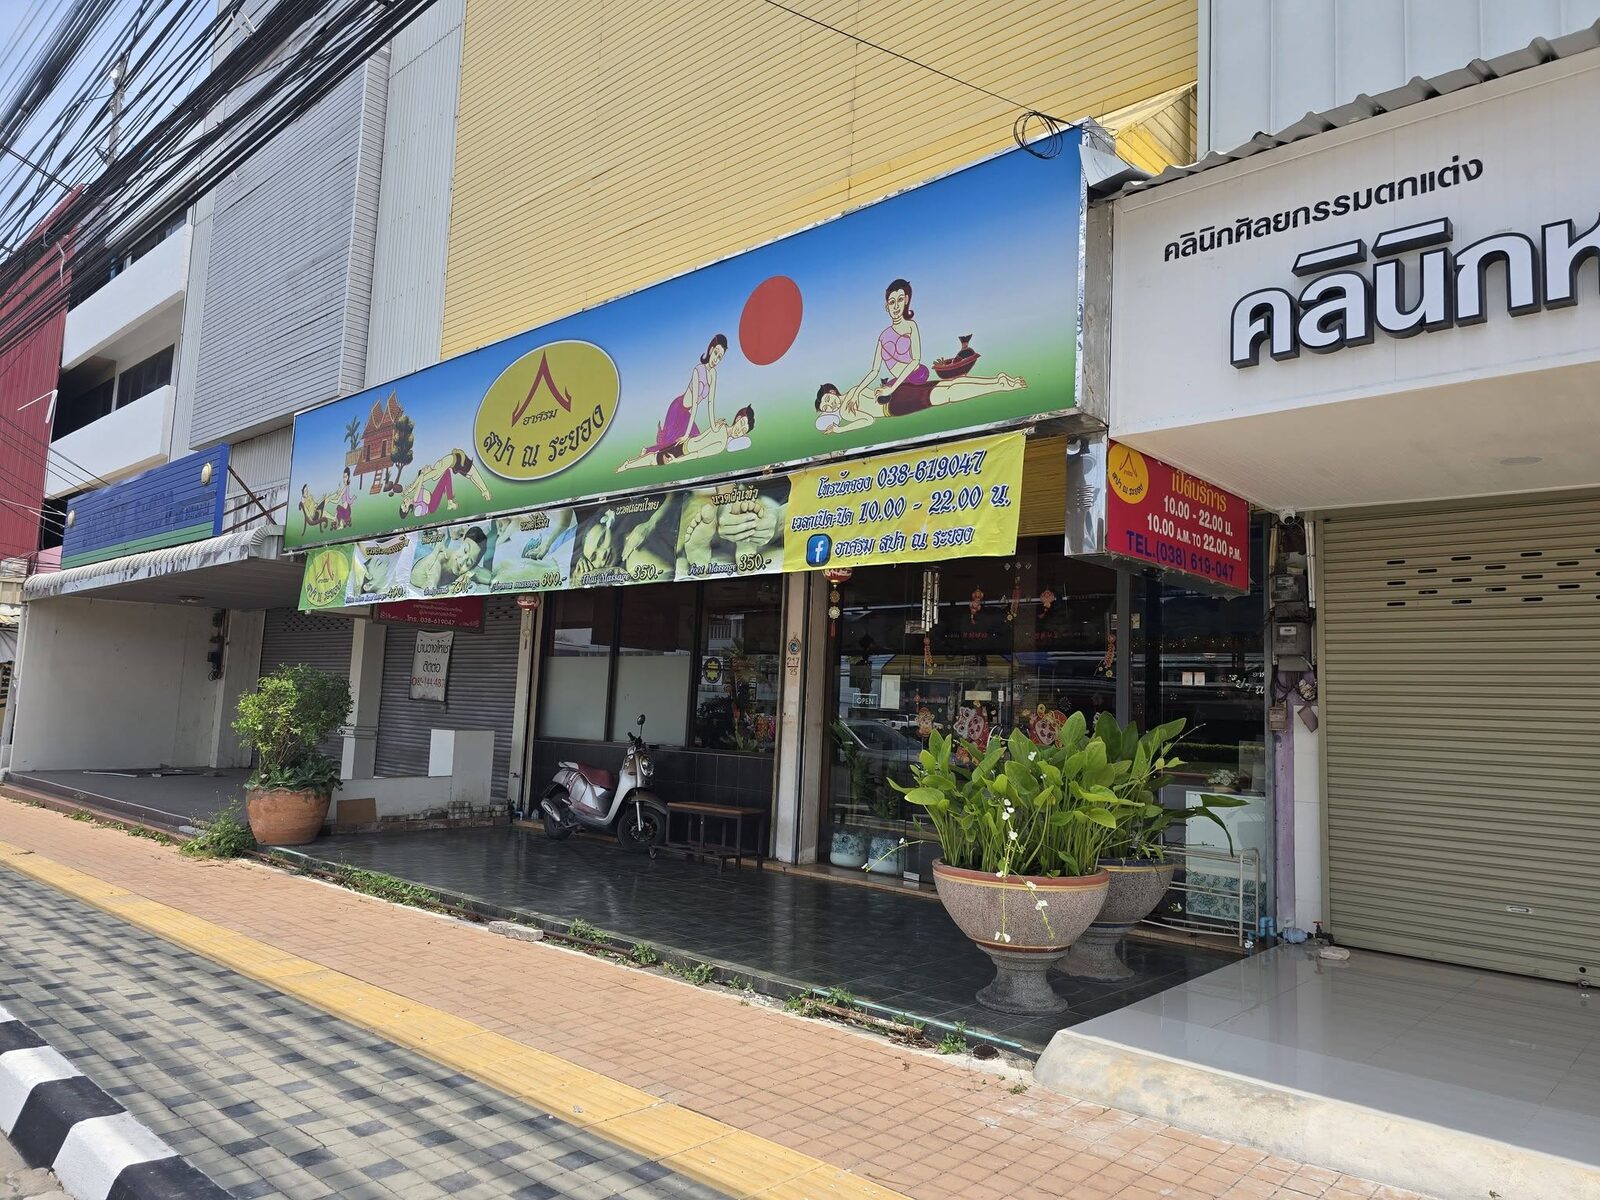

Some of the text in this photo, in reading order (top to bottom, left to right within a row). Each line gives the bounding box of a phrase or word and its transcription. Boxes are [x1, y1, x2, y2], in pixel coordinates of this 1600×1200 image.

[1164, 154, 1484, 263] คลินิกศัลยกรรมตกแต่ง
[521, 444, 540, 467] ณ
[547, 403, 605, 462] ระยอง
[877, 449, 987, 488] 038-619047
[858, 496, 906, 524] 10.00
[929, 485, 983, 515] 22.00
[990, 484, 1012, 506] น.
[1171, 470, 1227, 513] เปิดบริการ
[1164, 495, 1189, 521] 10.00
[1199, 509, 1223, 532] 22.00
[1225, 521, 1233, 537] น.
[879, 530, 906, 553] สปา
[911, 529, 927, 550] ณ
[932, 525, 976, 548] ระยอง
[1147, 513, 1242, 561] 10.00 A.M. TO 22.00 P.M.
[633, 565, 663, 580] 350.-
[708, 562, 738, 576] Massage
[739, 553, 772, 571] 350.-
[1191, 554, 1235, 582] 619-047
[856, 697, 875, 705] OPEN
